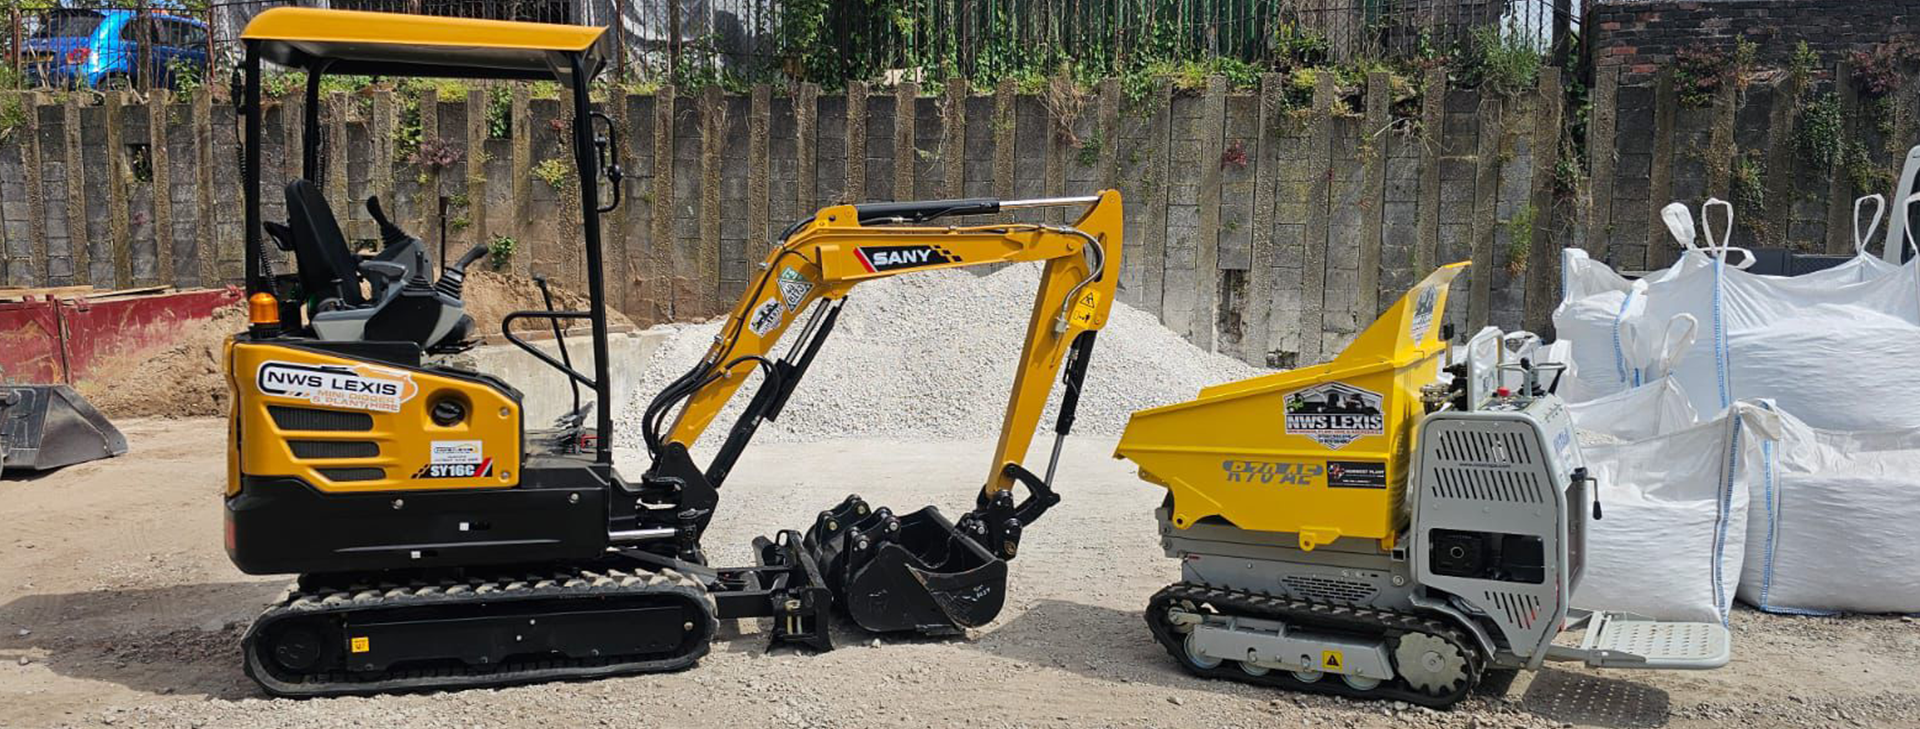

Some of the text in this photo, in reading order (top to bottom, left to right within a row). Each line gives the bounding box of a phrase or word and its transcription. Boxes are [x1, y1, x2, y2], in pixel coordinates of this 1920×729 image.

[873, 249, 931, 266] SANY
[268, 371, 397, 396] NWS LEXIS
[318, 389, 395, 404] MINI DIGGER
[1287, 415, 1382, 430] NWS LEXIS
[430, 464, 475, 477] SY16C
[1226, 460, 1276, 484] R70
